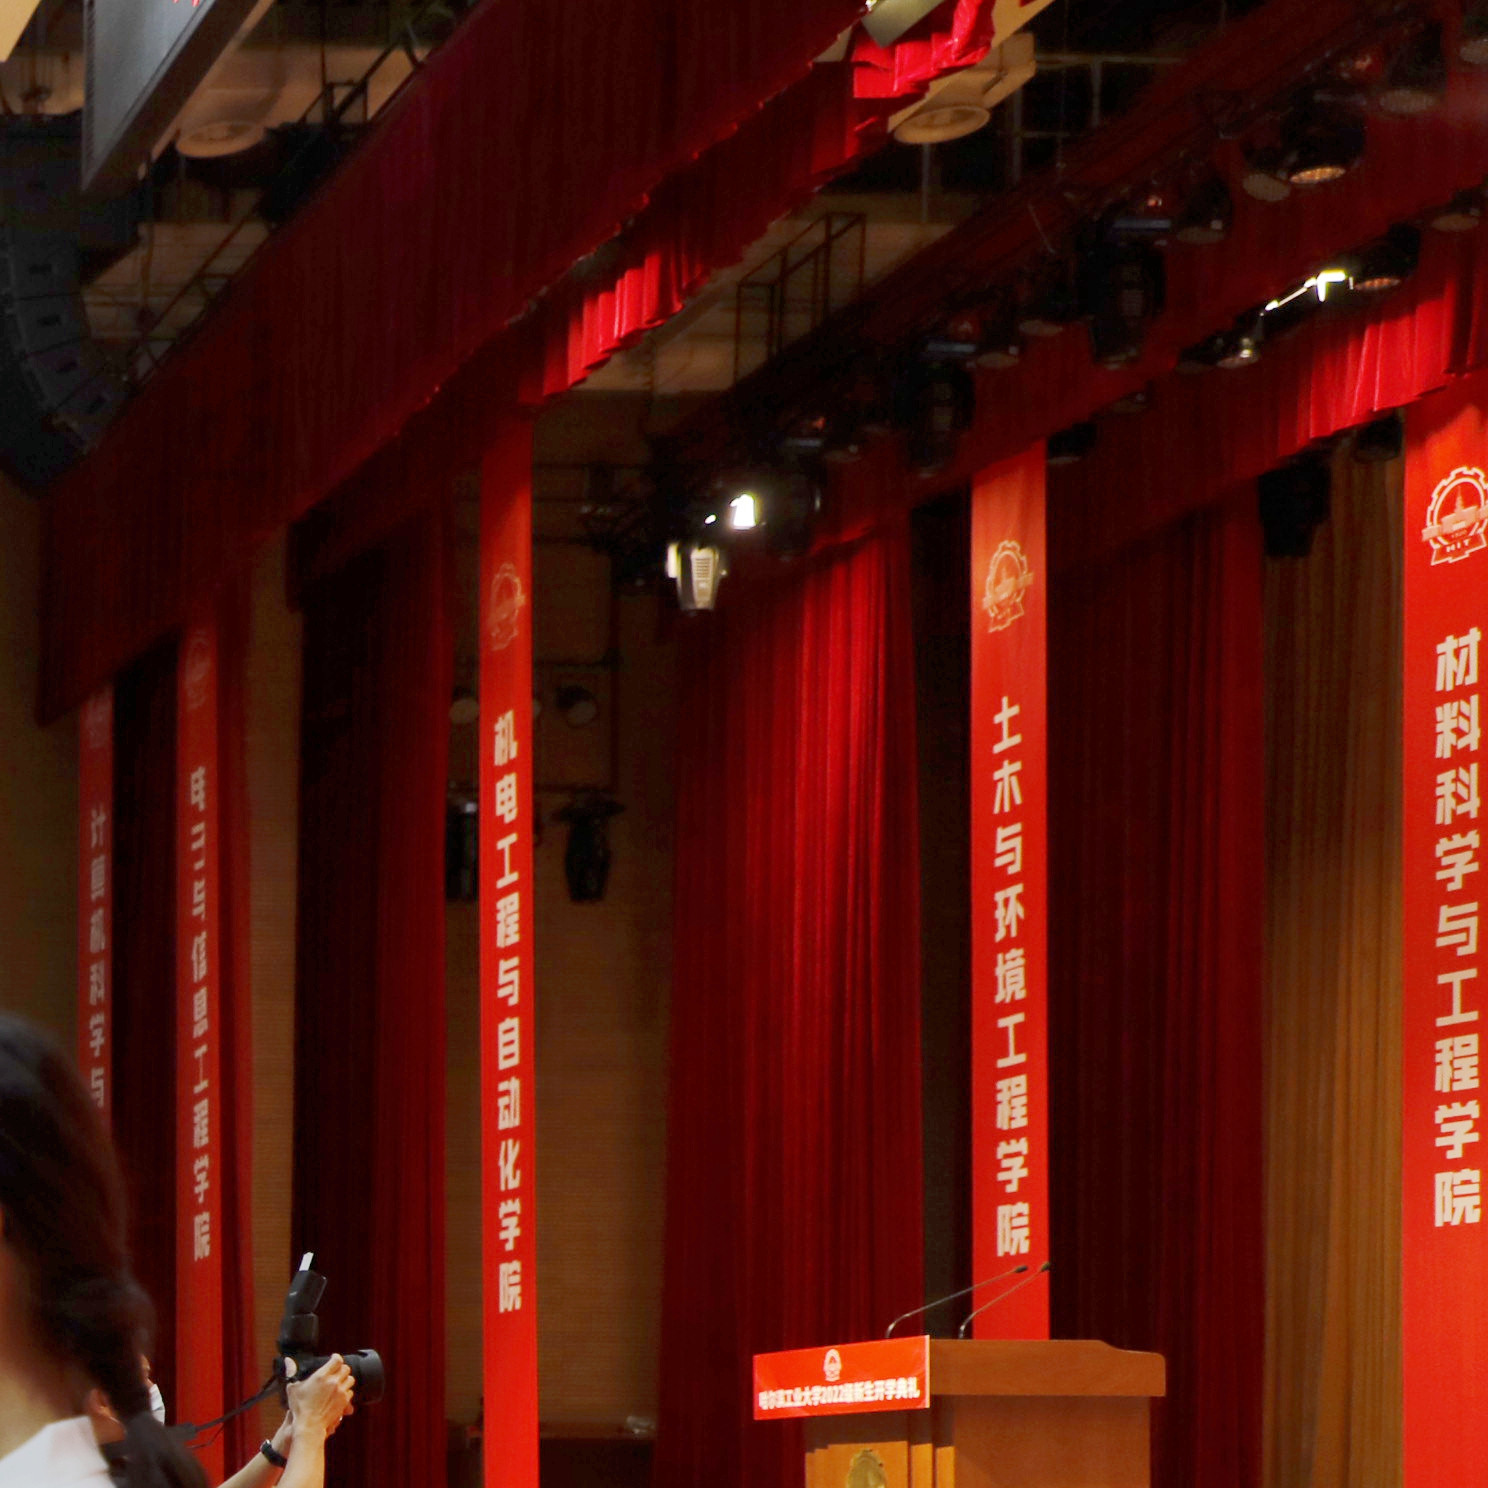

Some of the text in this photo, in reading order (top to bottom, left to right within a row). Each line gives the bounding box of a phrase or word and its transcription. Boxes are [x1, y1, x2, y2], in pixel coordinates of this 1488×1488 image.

[494, 711, 522, 1313] 机电工程与自动化学院
[993, 696, 1030, 1257] 土木与环境工程学院
[1435, 627, 1482, 1227] 材料科学与工程学院
